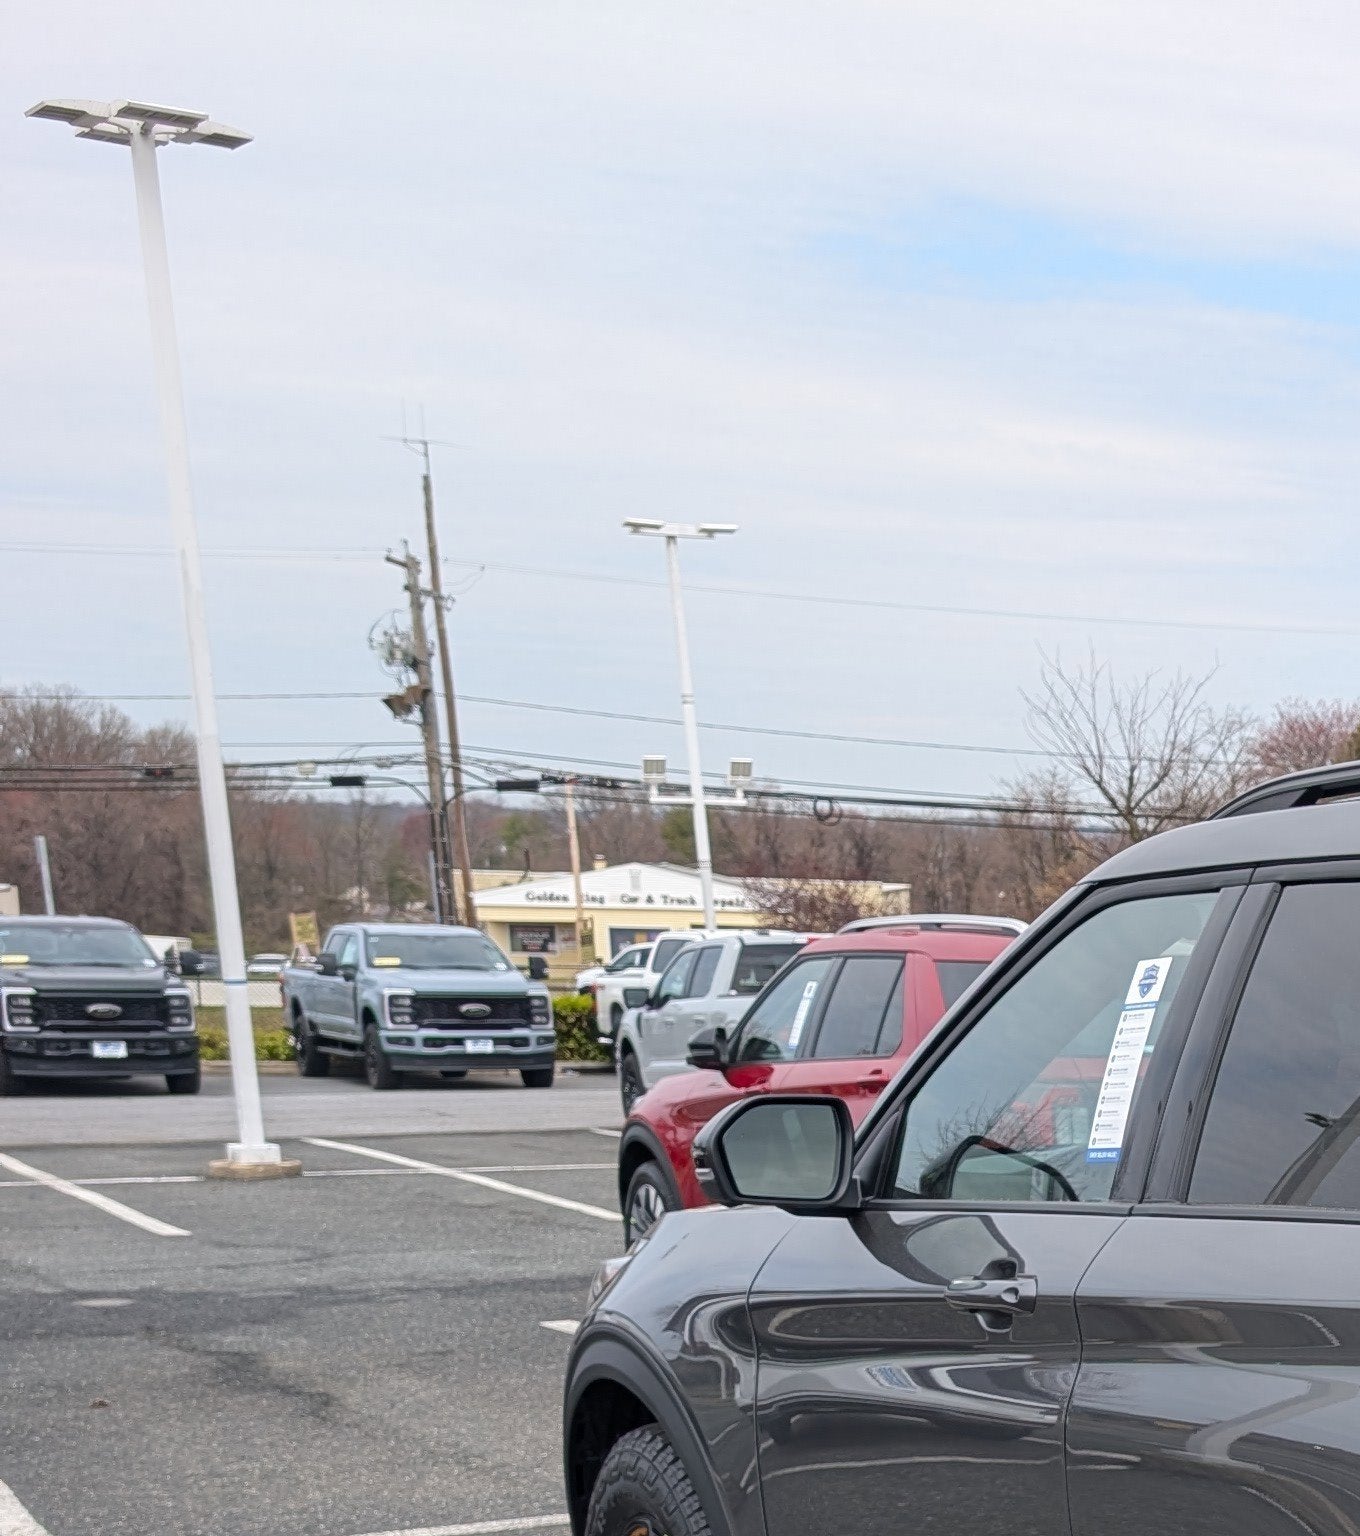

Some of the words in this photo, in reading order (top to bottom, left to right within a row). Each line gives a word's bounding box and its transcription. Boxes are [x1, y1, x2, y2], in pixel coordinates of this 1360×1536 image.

[619, 893, 640, 904] Car
[645, 894, 655, 905] &
[660, 894, 697, 906] Truck
